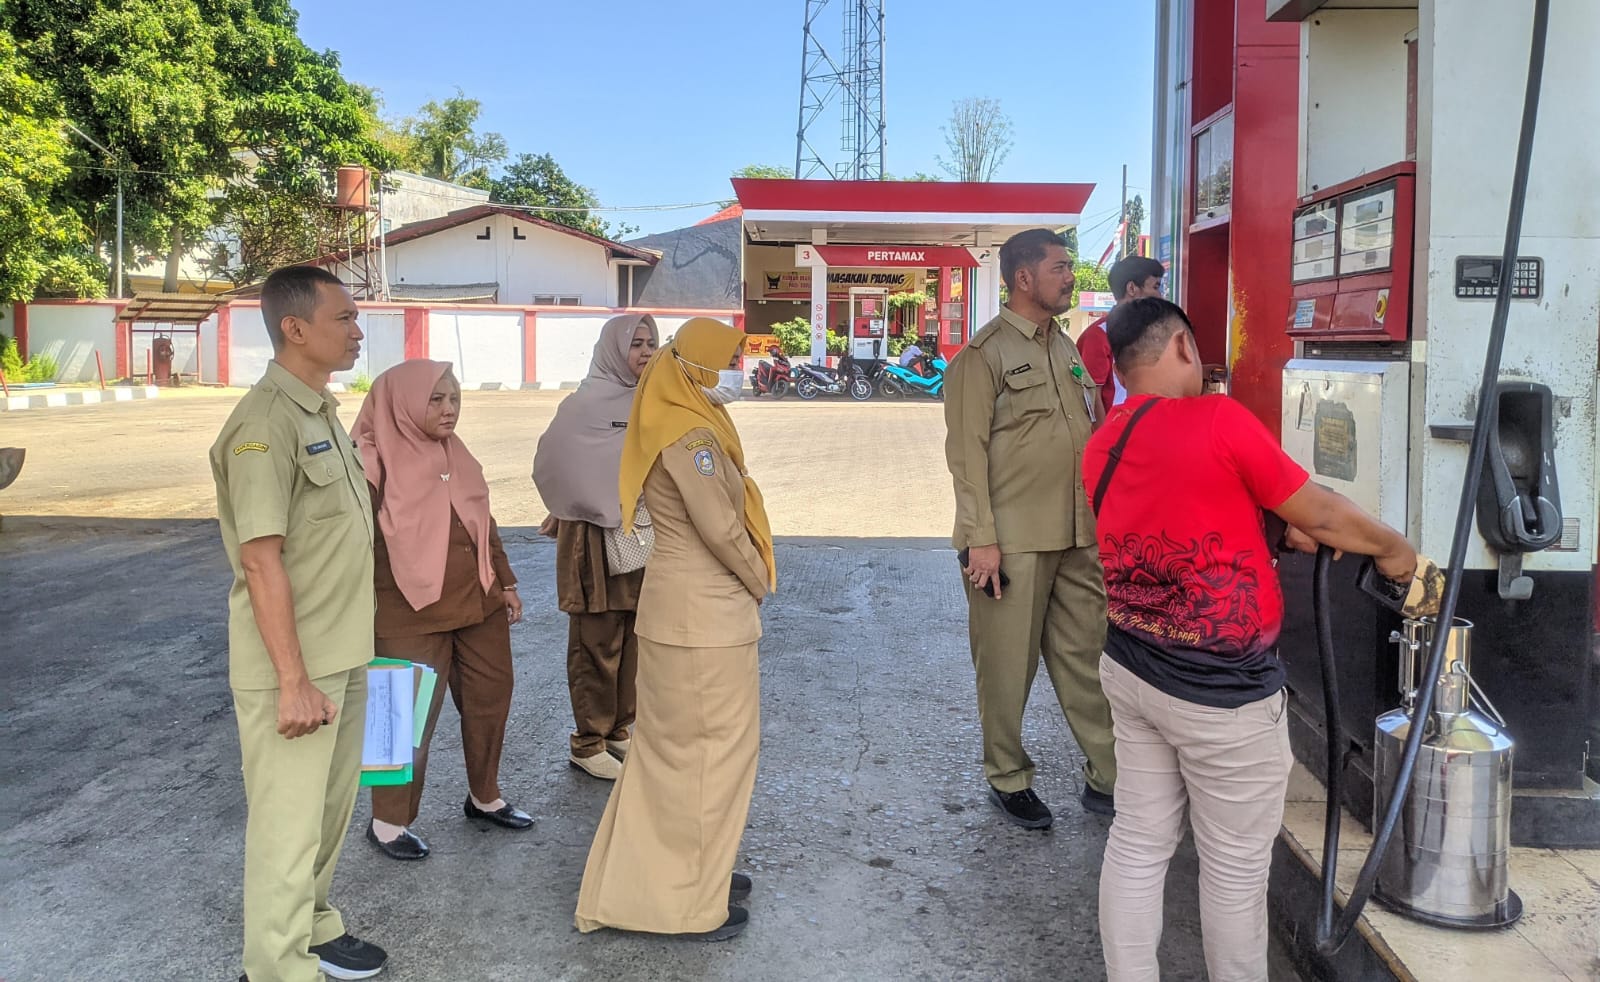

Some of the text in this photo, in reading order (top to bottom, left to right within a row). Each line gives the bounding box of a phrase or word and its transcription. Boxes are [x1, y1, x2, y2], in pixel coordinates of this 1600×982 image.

[803, 251, 810, 260] 3
[867, 251, 925, 261] PERTAMAX
[827, 272, 905, 284] MASAKAN PADANG
[1167, 625, 1200, 645] Happy
